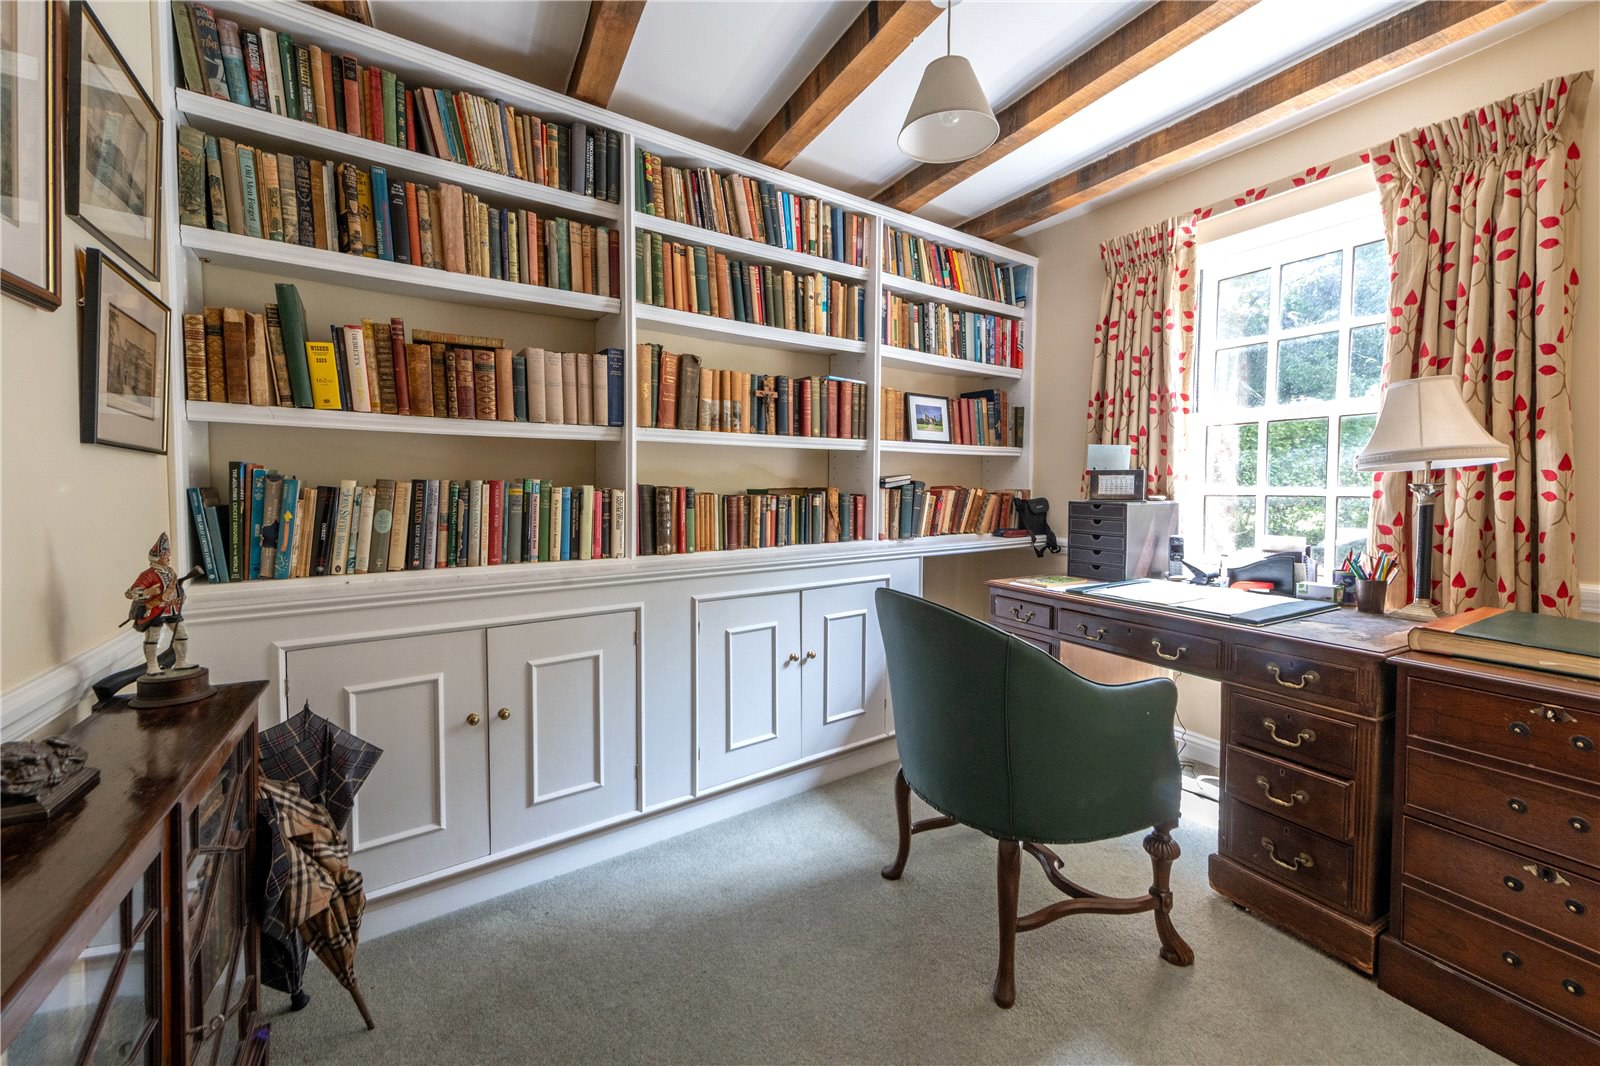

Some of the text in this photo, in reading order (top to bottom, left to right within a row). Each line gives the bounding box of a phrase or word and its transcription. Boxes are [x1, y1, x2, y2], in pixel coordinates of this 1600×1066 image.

[246, 33, 257, 43] VAL
[299, 47, 311, 87] KEN FOLLETT
[244, 164, 257, 222] Old Men Forget
[351, 333, 361, 366] DEBRETT'S
[415, 483, 424, 500] CLARE
[473, 485, 481, 508] YOUNG
[414, 500, 423, 524] FRANCIS
